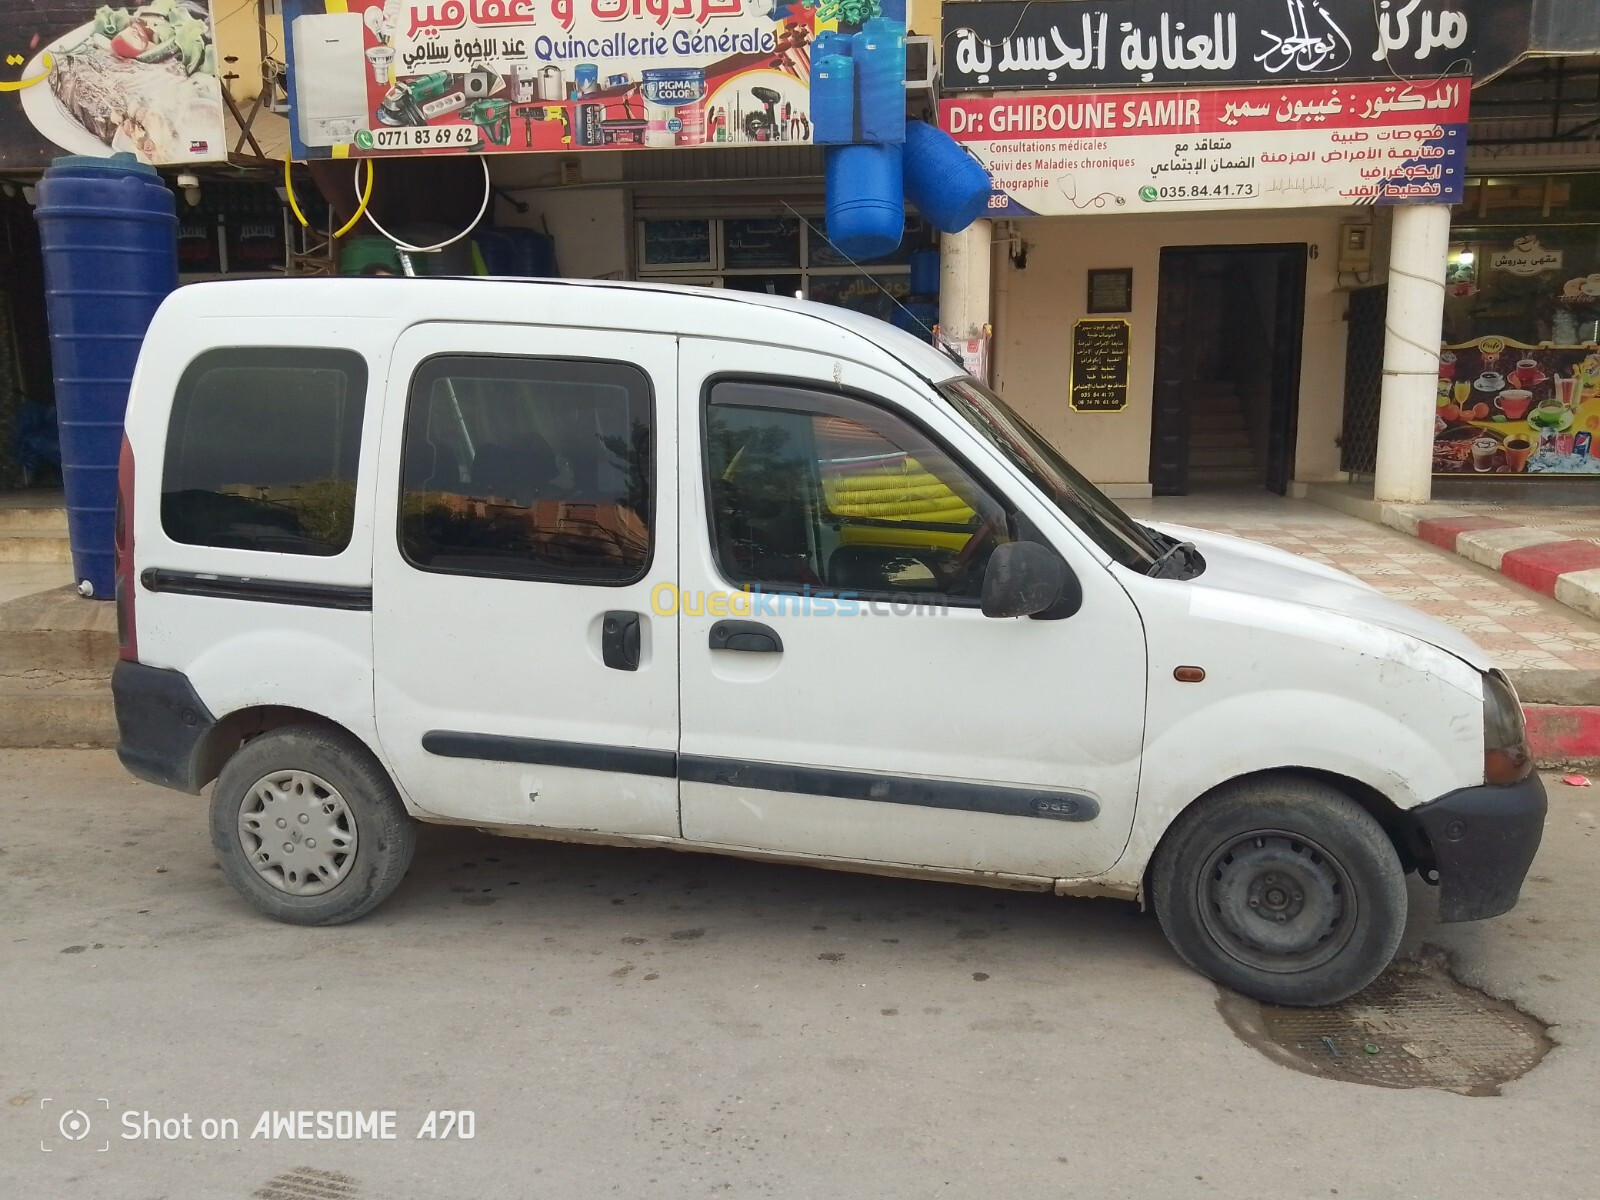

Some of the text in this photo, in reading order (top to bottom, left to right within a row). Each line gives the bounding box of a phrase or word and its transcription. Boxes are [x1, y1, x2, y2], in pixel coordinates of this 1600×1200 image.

[1371, 0, 1469, 62] مركز
[501, 38, 527, 57] عند
[534, 28, 775, 61] Quincallerie Générale
[956, 12, 1109, 85] الجسدية
[1120, 12, 1237, 83] للعناية
[402, 41, 450, 69] سلامي
[1217, 100, 1271, 126] سمير
[1275, 89, 1343, 122] غيبون
[950, 98, 1201, 134] Dr: GHIBOUNE SAMIR
[377, 127, 473, 146] 0771 83 69 62
[1331, 126, 1445, 144] فحوصات طبية
[989, 140, 1108, 154] Consultations médicales
[1174, 137, 1232, 156] متعاقد مع
[1260, 146, 1445, 165] متابعة الأمراض المزمنة
[989, 156, 1136, 172] Suivi des Maladies chroniques
[1150, 156, 1255, 179] الضمان الإجتماعي
[1359, 164, 1442, 180] إيكوغرافيا
[1159, 184, 1253, 198] 035.84.41.73
[1338, 182, 1441, 199] تخطيط القلب
[988, 195, 1008, 207] ECG
[1308, 243, 1320, 260] 6
